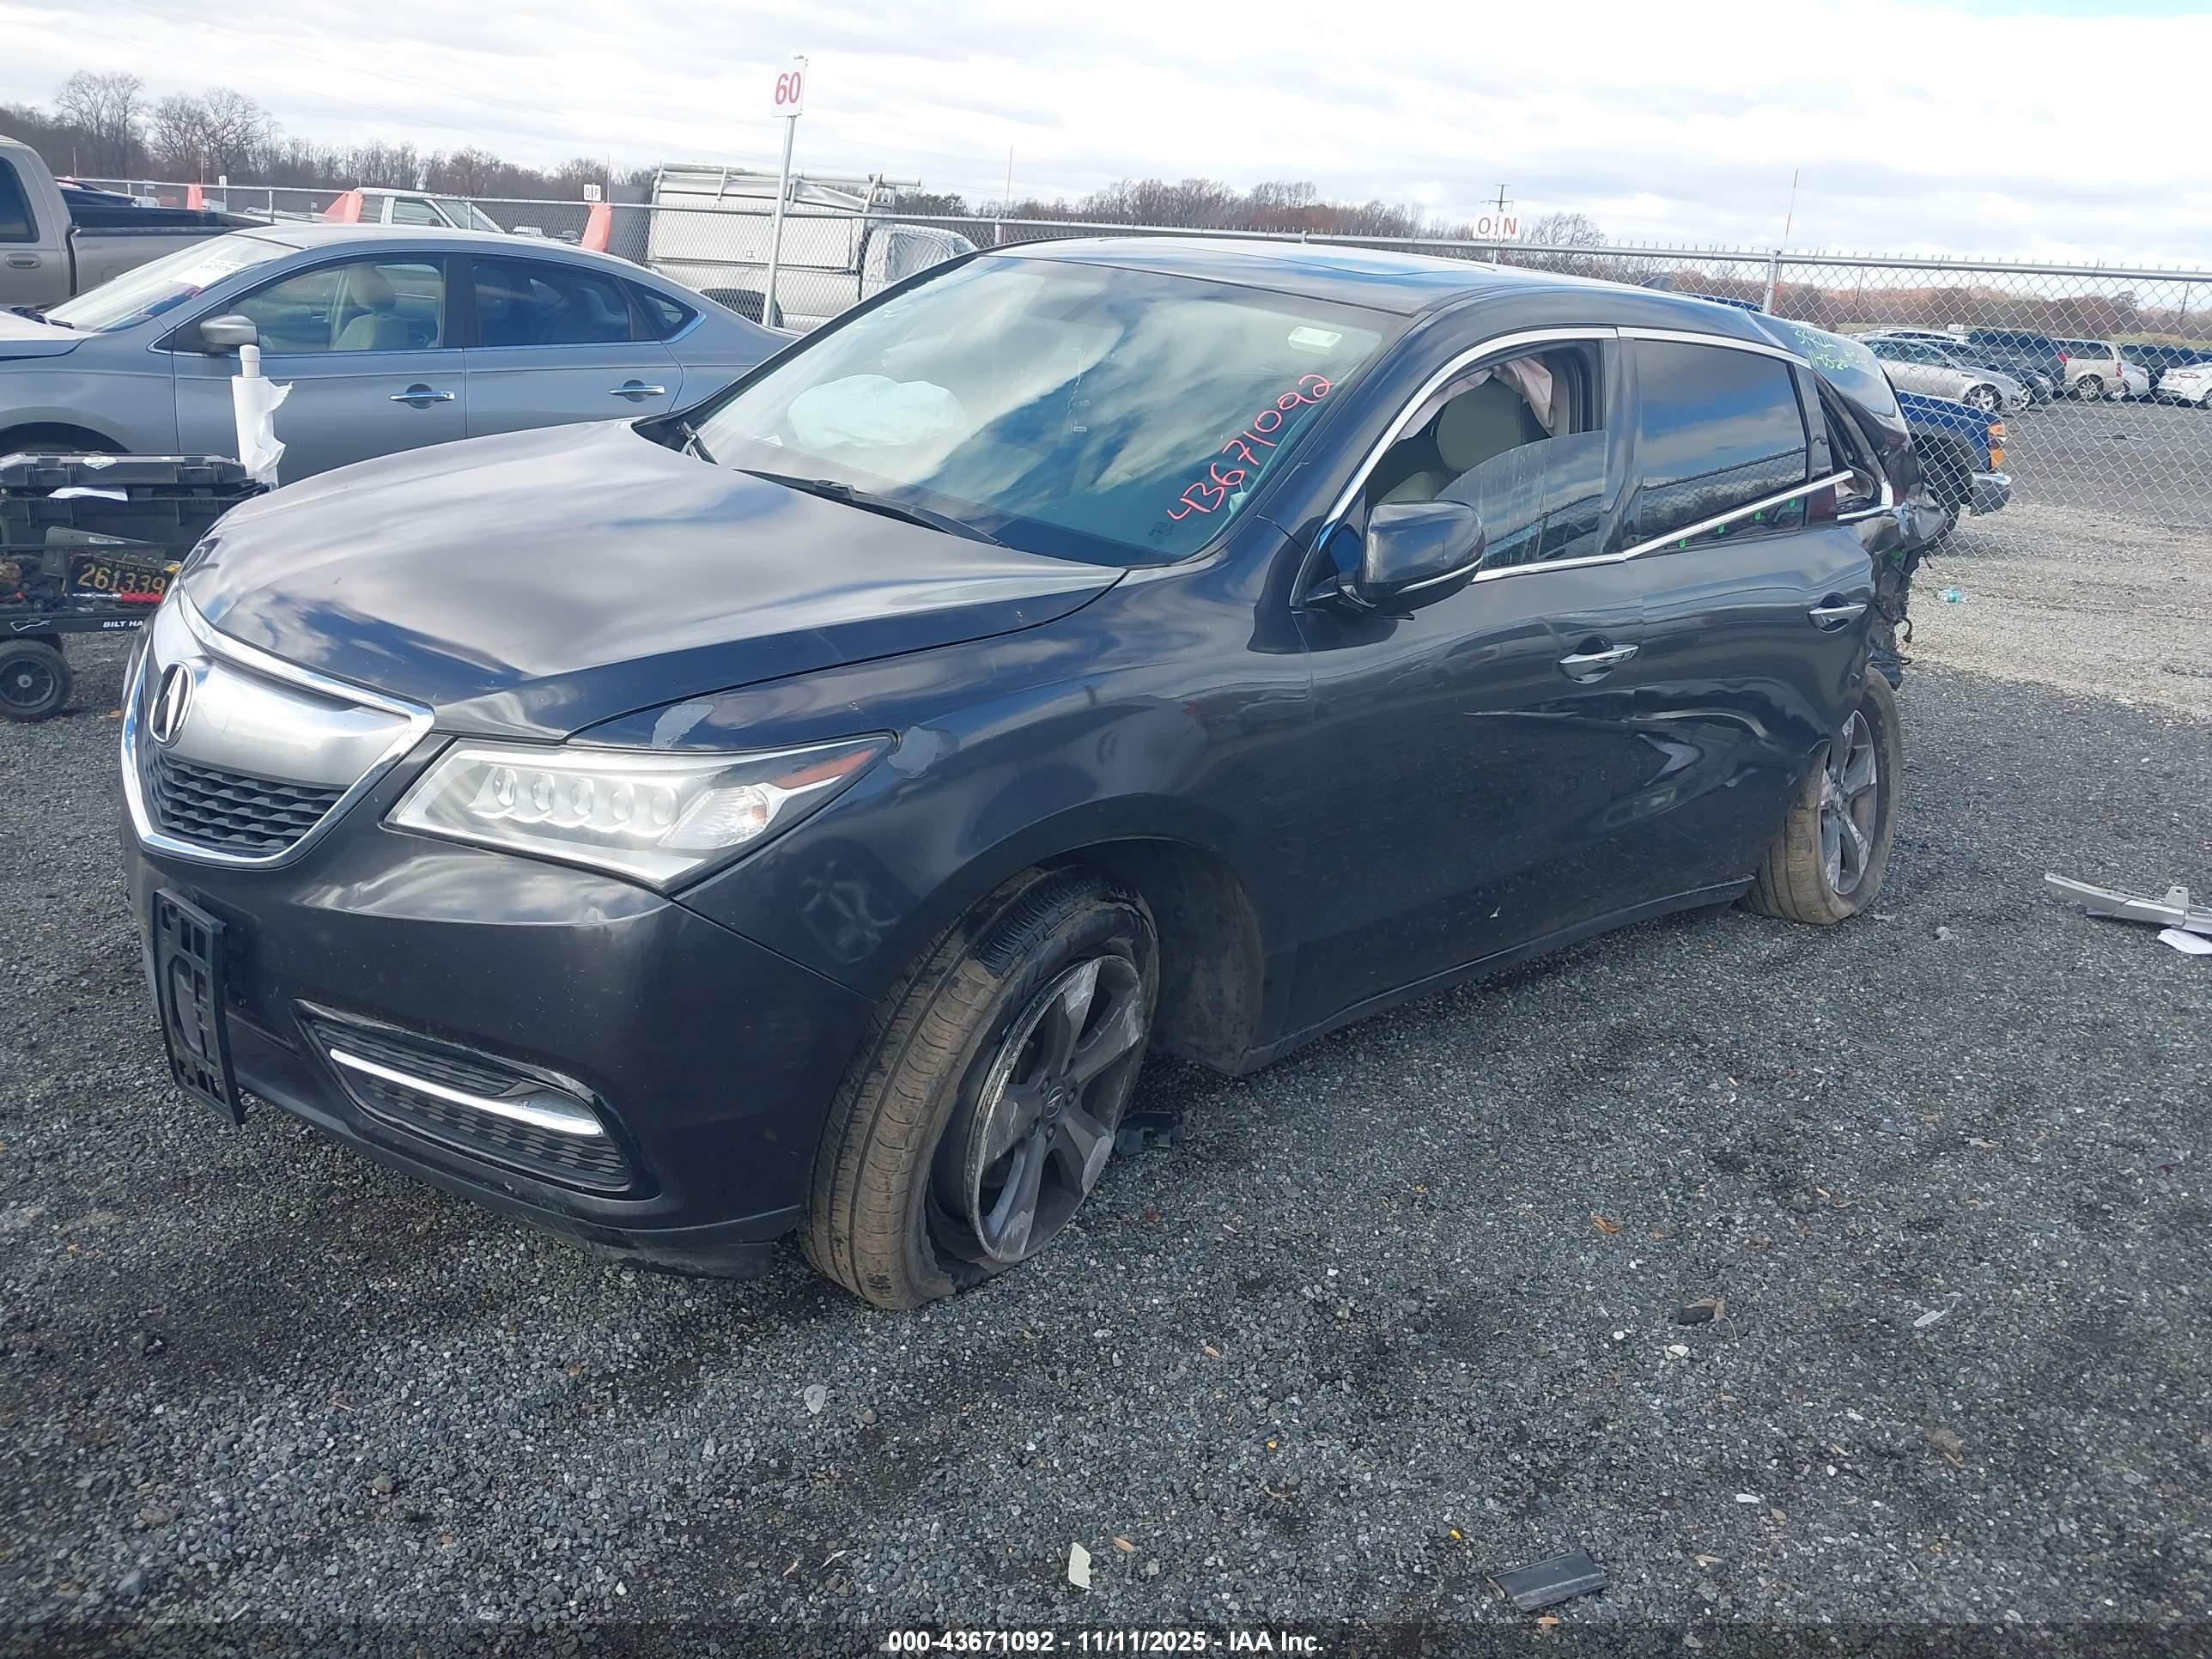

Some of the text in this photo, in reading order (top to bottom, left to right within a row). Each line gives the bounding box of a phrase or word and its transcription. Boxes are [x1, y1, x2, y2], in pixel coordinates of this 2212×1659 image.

[775, 71, 801, 105] 60
[1166, 374, 1334, 520] 43671092
[77, 562, 167, 595] 261339
